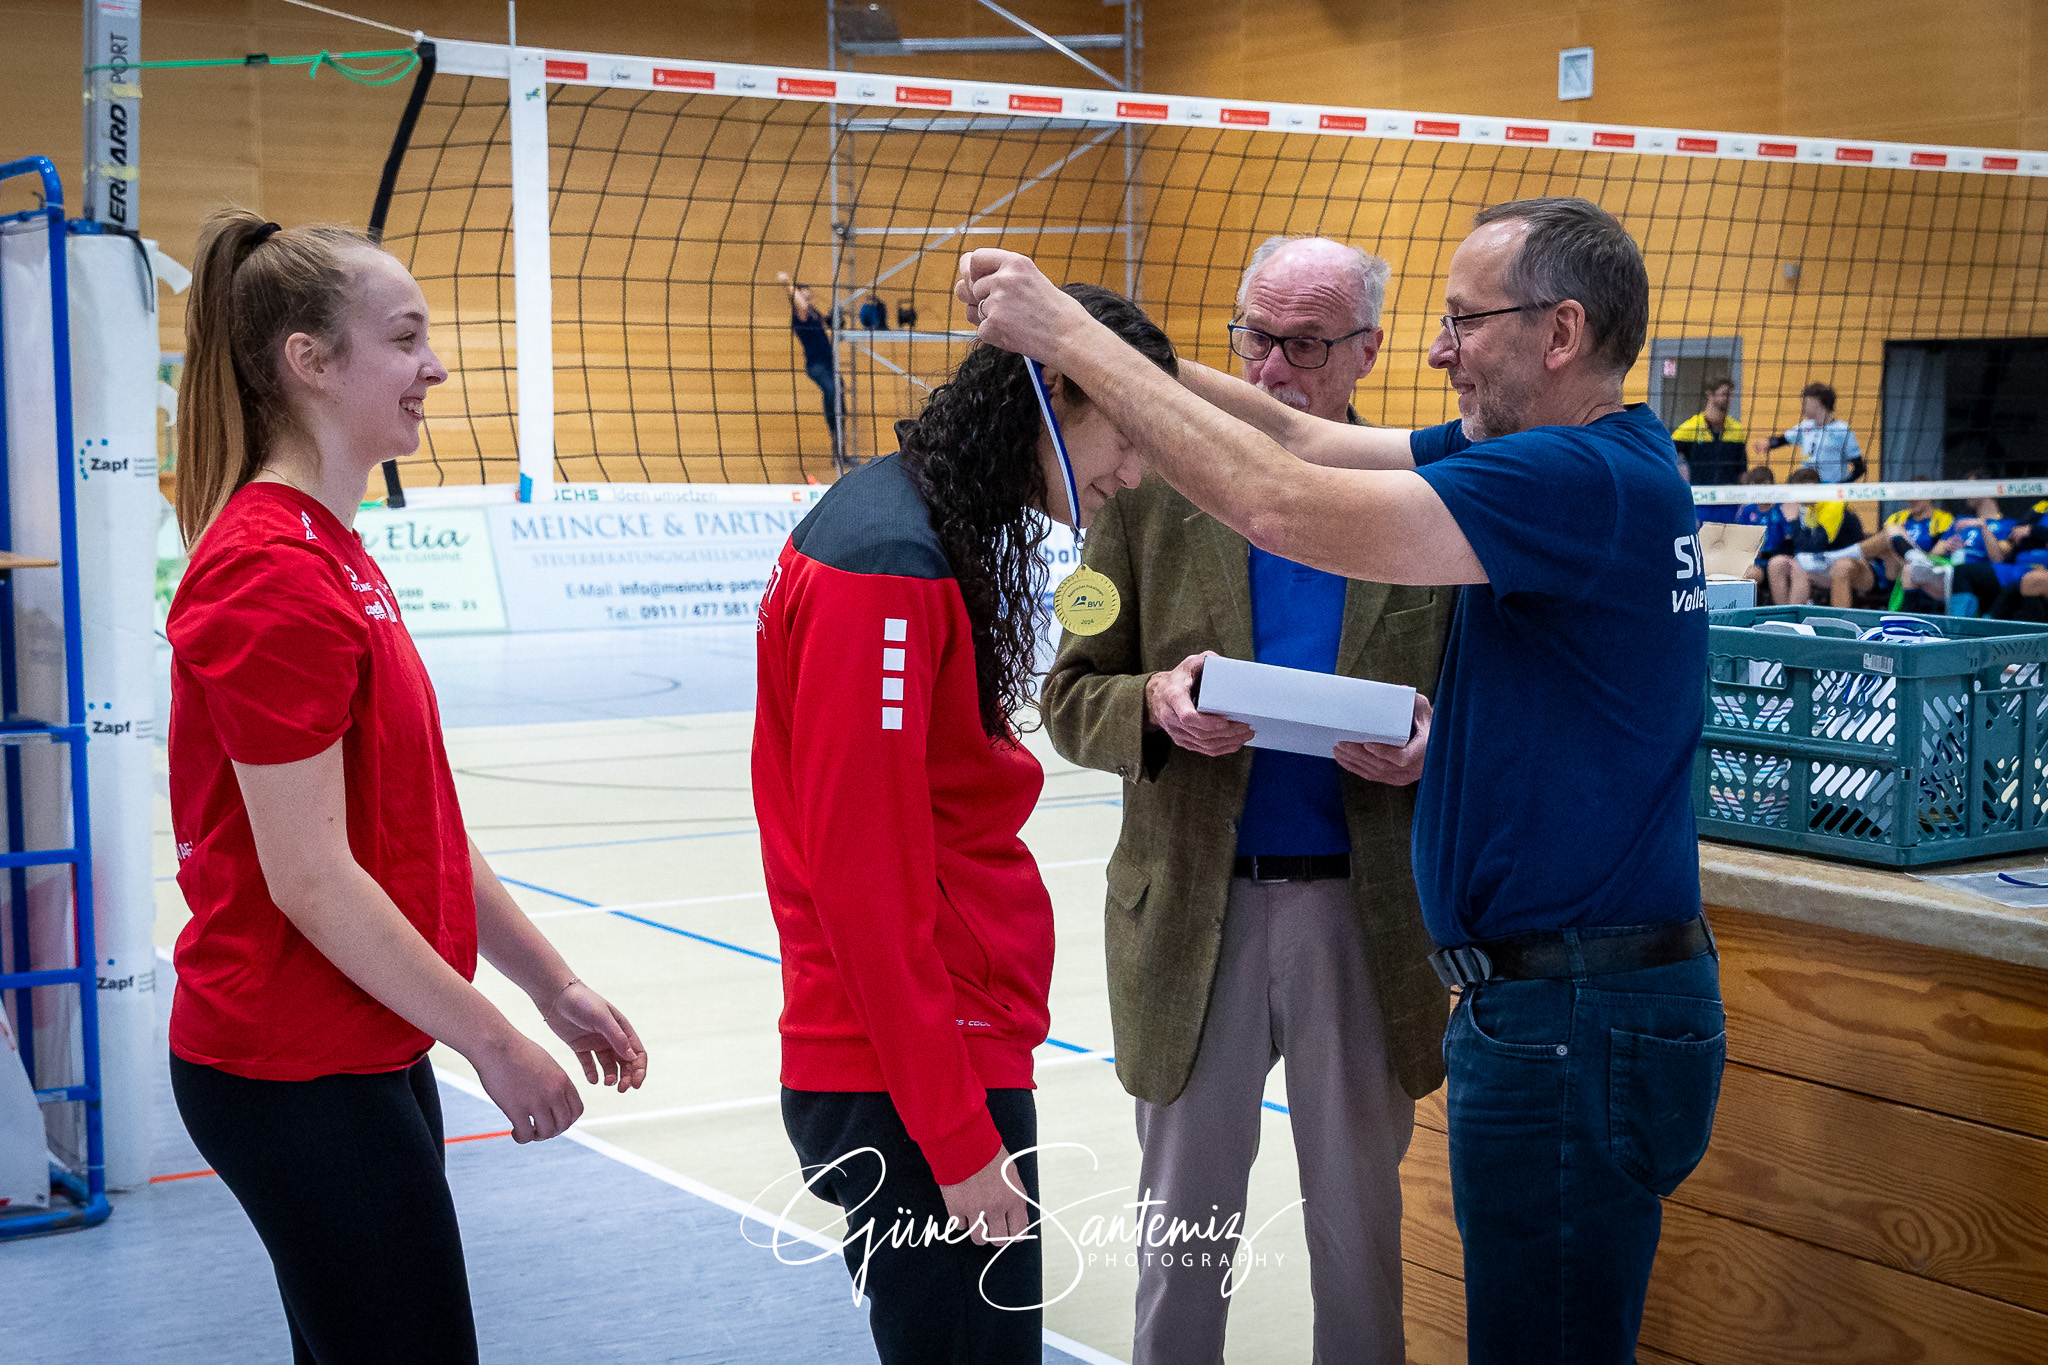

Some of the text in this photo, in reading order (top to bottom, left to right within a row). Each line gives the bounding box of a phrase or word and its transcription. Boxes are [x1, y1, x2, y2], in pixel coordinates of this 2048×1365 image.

[109, 32, 128, 224] ERARD PORT
[91, 458, 128, 473] Zapf
[554, 489, 600, 501] CHS
[511, 510, 807, 540] MEINCKE & PARTNE
[386, 521, 471, 551] Elia
[1087, 600, 1104, 608] BVV
[93, 720, 130, 736] Zapf
[97, 975, 134, 992] Zapf
